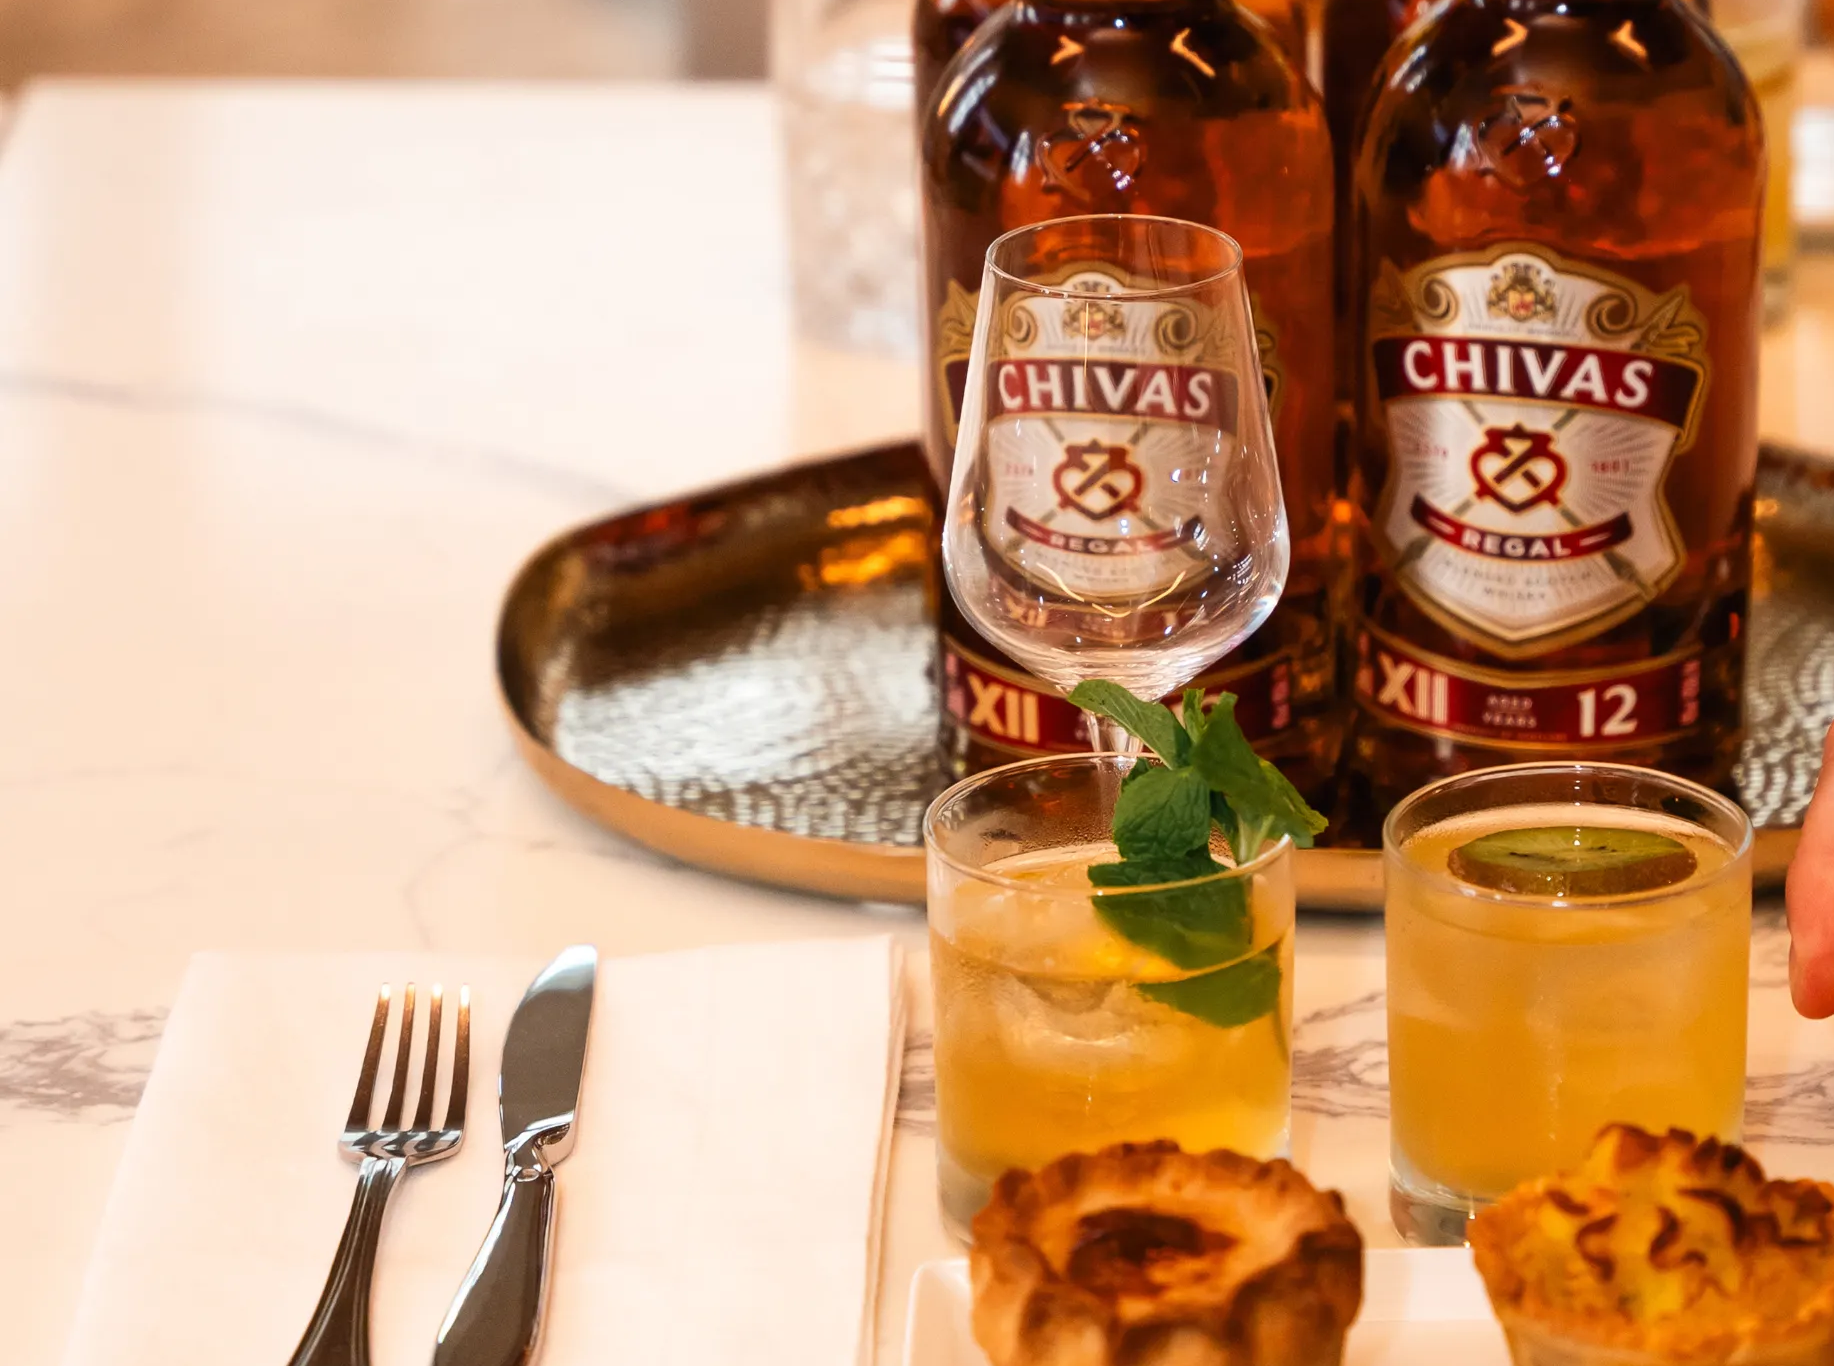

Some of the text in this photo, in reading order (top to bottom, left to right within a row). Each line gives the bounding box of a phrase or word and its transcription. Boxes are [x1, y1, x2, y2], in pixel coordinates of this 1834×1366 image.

[998, 364, 1213, 418] CHIVAS
[1403, 340, 1654, 408] CHIVAS
[1050, 533, 1154, 555] REGAL
[1460, 526, 1572, 558] REGAL
[967, 673, 1040, 745] XII
[1377, 650, 1449, 725] XII
[1486, 693, 1534, 710] AGED
[1577, 684, 1639, 738] 12
[1481, 711, 1538, 729] YEARS
